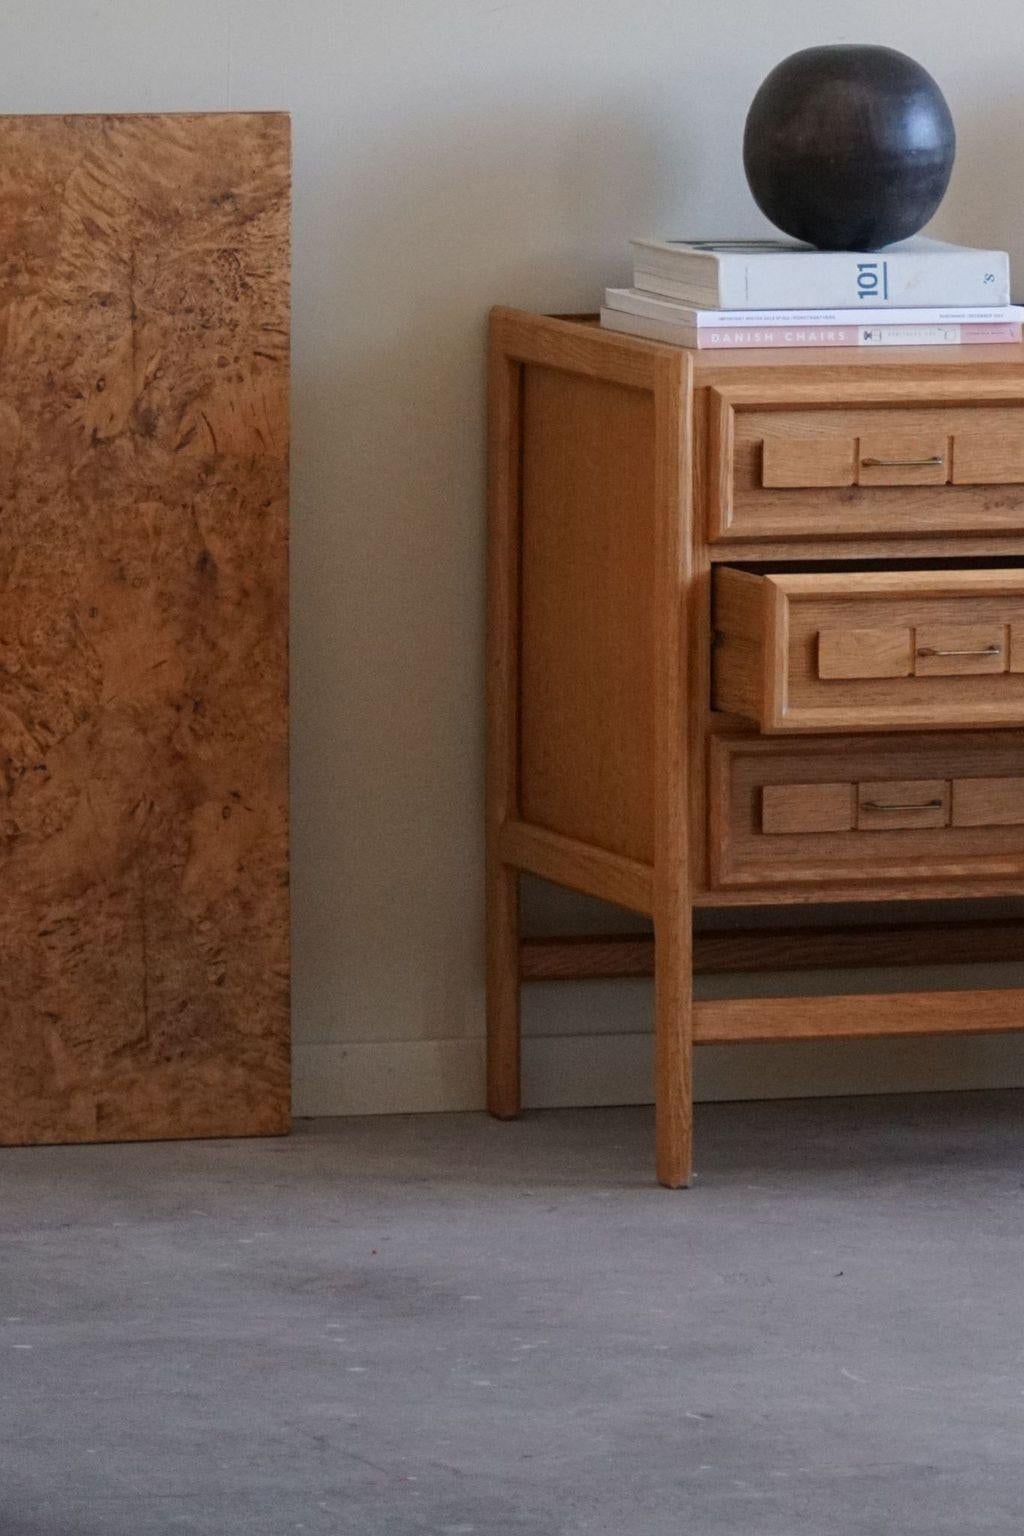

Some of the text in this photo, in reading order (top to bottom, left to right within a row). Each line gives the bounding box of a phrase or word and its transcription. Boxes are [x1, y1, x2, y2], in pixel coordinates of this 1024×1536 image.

[857, 263, 878, 299] 101
[711, 331, 846, 343] DANISH CHAIRS
